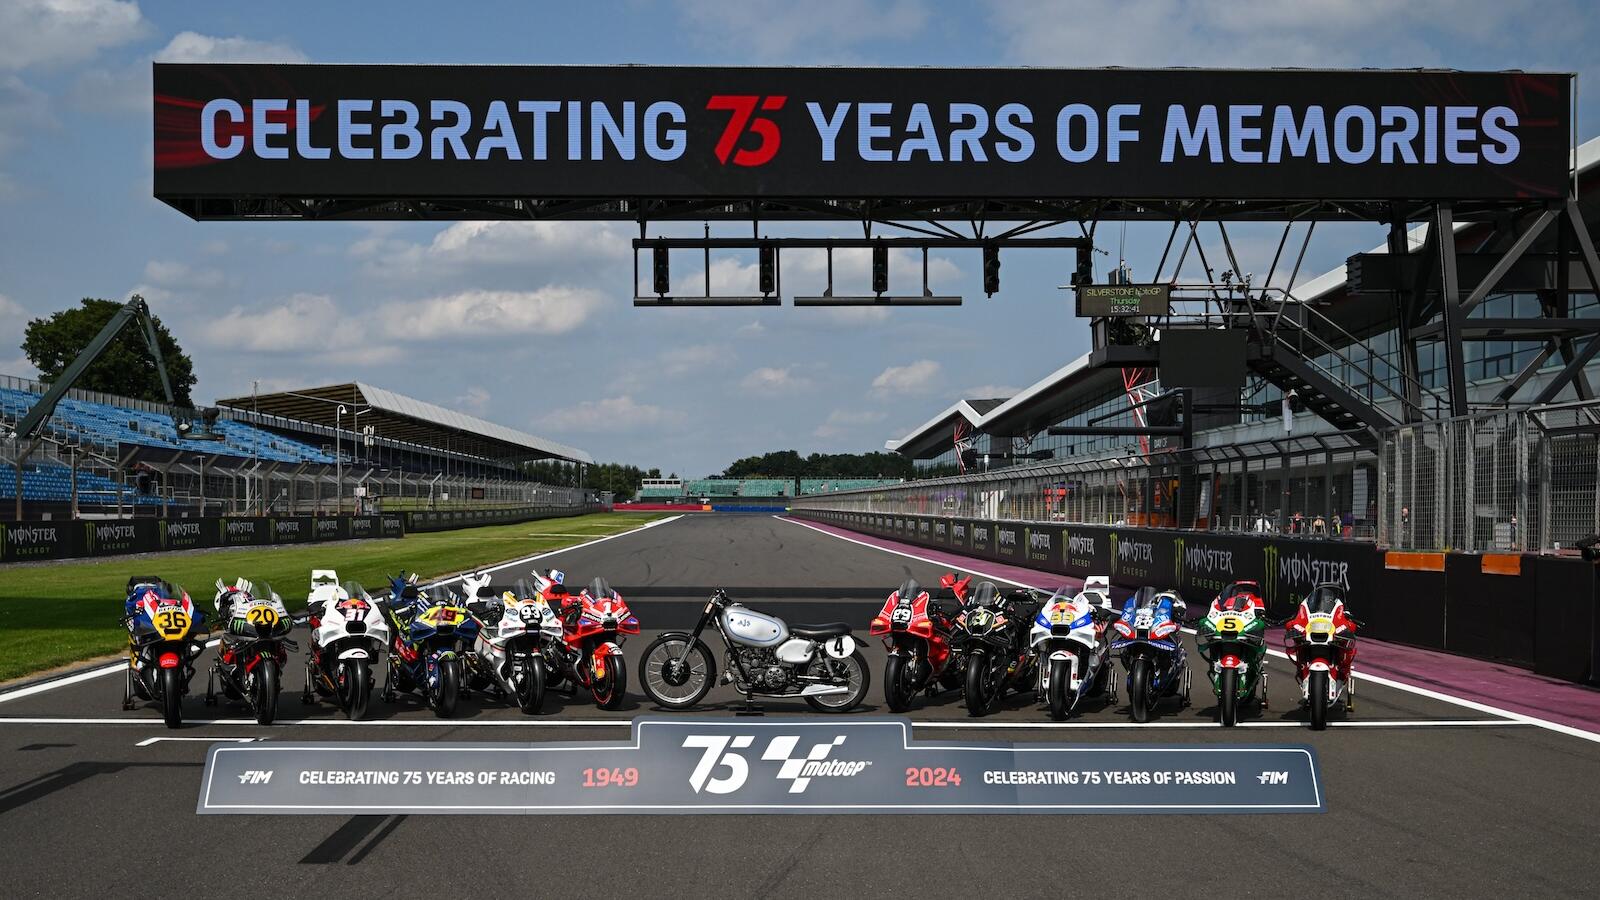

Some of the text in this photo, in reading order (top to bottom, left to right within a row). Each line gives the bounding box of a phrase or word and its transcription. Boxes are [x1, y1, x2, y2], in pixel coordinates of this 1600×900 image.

[201, 95, 1521, 167] CELEBRATING 75 YEARS OF MEMORIES
[1086, 288, 1134, 297] SILVERSTONE
[1110, 297, 1141, 305] Thursday
[1110, 305, 1140, 313] 15:32:41
[8, 525, 57, 544] MONSTER
[96, 523, 136, 541] MONSTER
[167, 521, 200, 537] MONSTER
[16, 546, 50, 555] ENERGY
[1068, 533, 1095, 555] MONSTER
[1118, 537, 1153, 563] MONSTER
[1185, 544, 1233, 574] MONSTER
[1123, 566, 1148, 577] ENERGY
[1280, 552, 1351, 591] MONSTER
[159, 612, 187, 628] 36
[251, 608, 275, 624] 20
[344, 608, 365, 621] 31
[520, 606, 541, 619] 93
[893, 608, 911, 621] 89
[1223, 618, 1237, 630] 5
[833, 638, 844, 656] 4
[681, 735, 756, 794] 75
[238, 770, 274, 784] FIM
[299, 770, 556, 785] CELEBRATING 75 YEARS OF RACING
[582, 767, 639, 787] 1949
[906, 767, 961, 786] 2024
[983, 770, 1236, 785] CELEBRATING 75 YEARS OF PASSION
[1256, 771, 1289, 785] FIM
